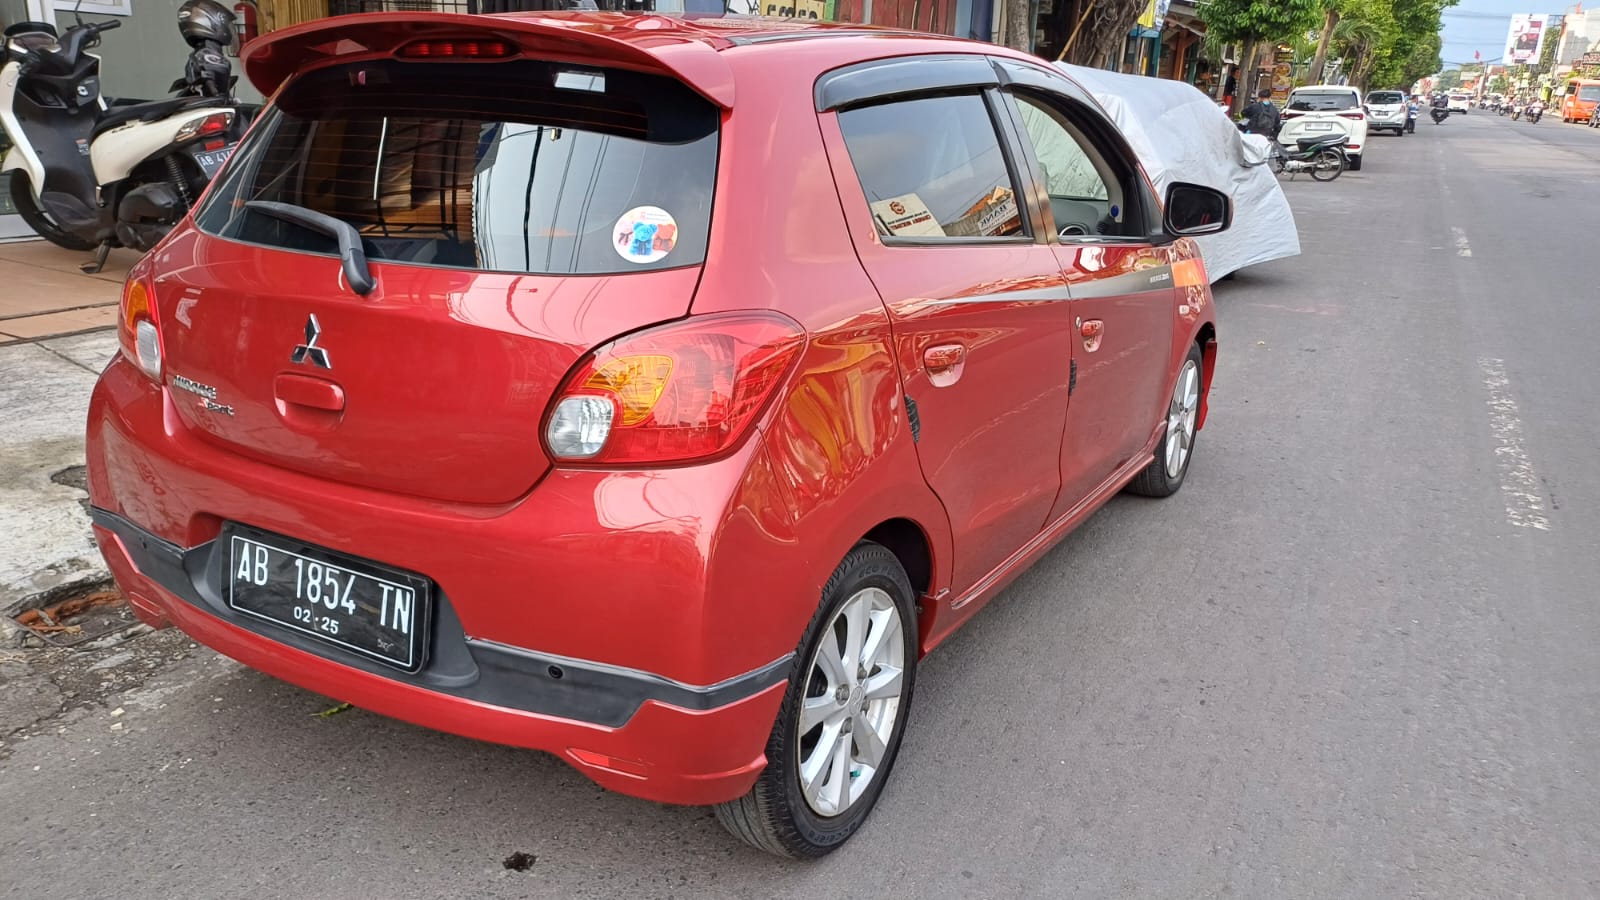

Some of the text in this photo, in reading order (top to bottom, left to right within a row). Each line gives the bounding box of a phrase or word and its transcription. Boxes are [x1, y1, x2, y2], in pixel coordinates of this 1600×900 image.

[200, 155, 215, 166] AB
[237, 542, 411, 634] AB 1854 TN
